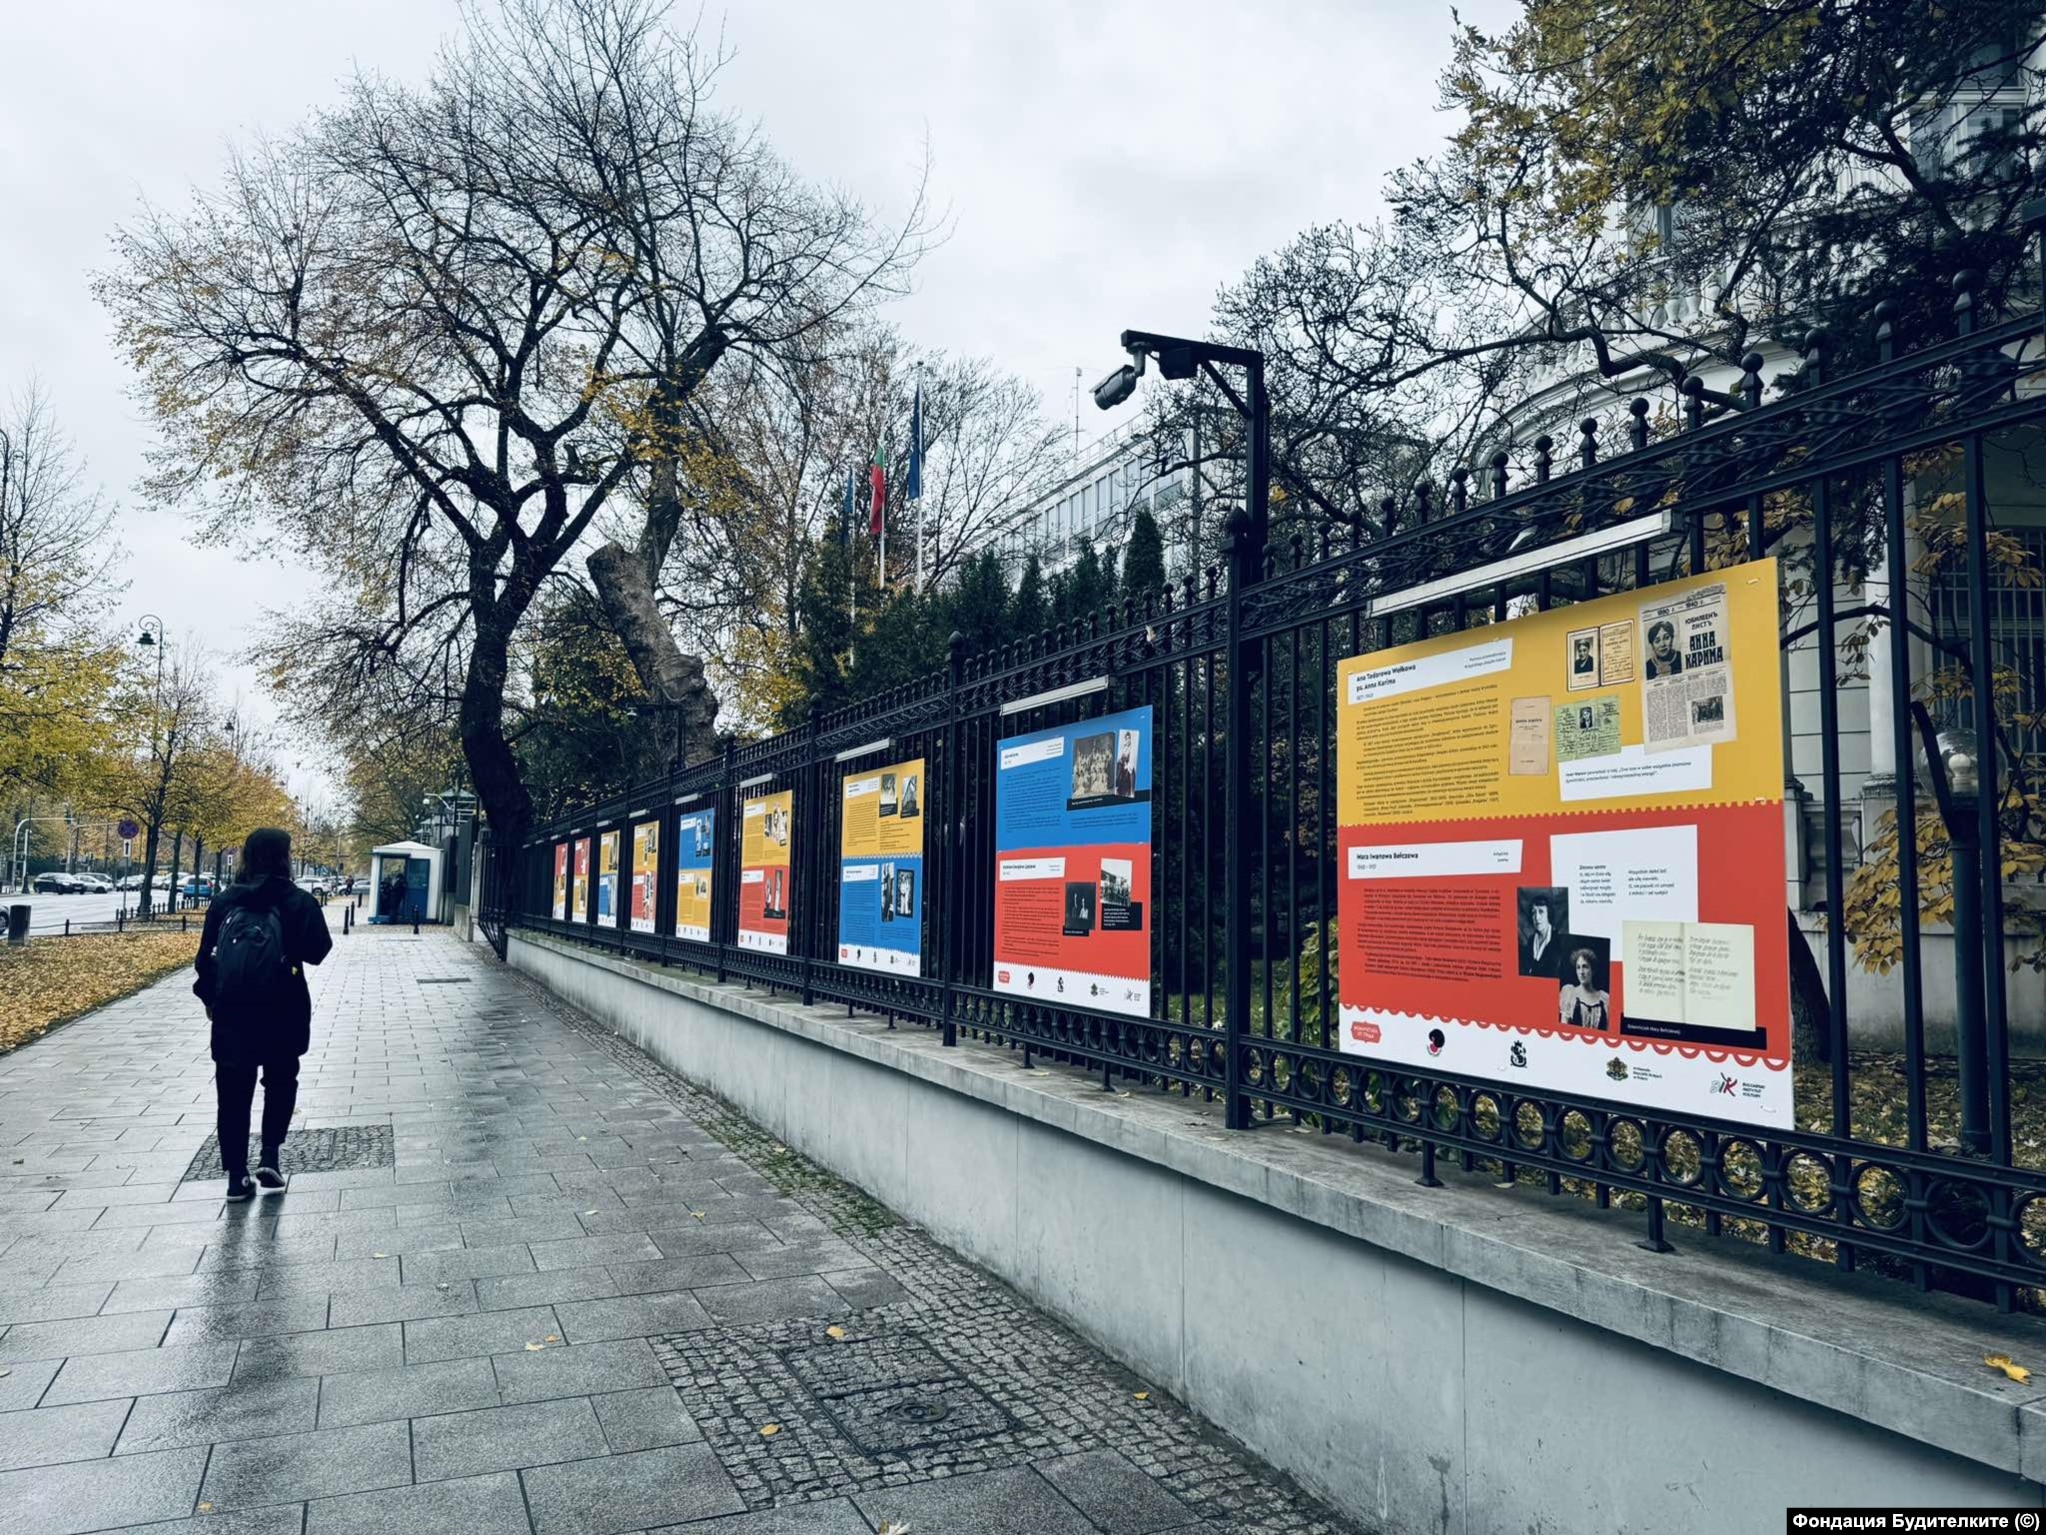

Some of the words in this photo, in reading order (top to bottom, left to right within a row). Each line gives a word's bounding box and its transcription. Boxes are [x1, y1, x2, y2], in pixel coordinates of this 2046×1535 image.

[1690, 631, 1716, 651] АННА
[1685, 647, 1723, 669] КАРИМА
[1367, 670, 1391, 680] Todorowa
[1378, 678, 1395, 687] Karima
